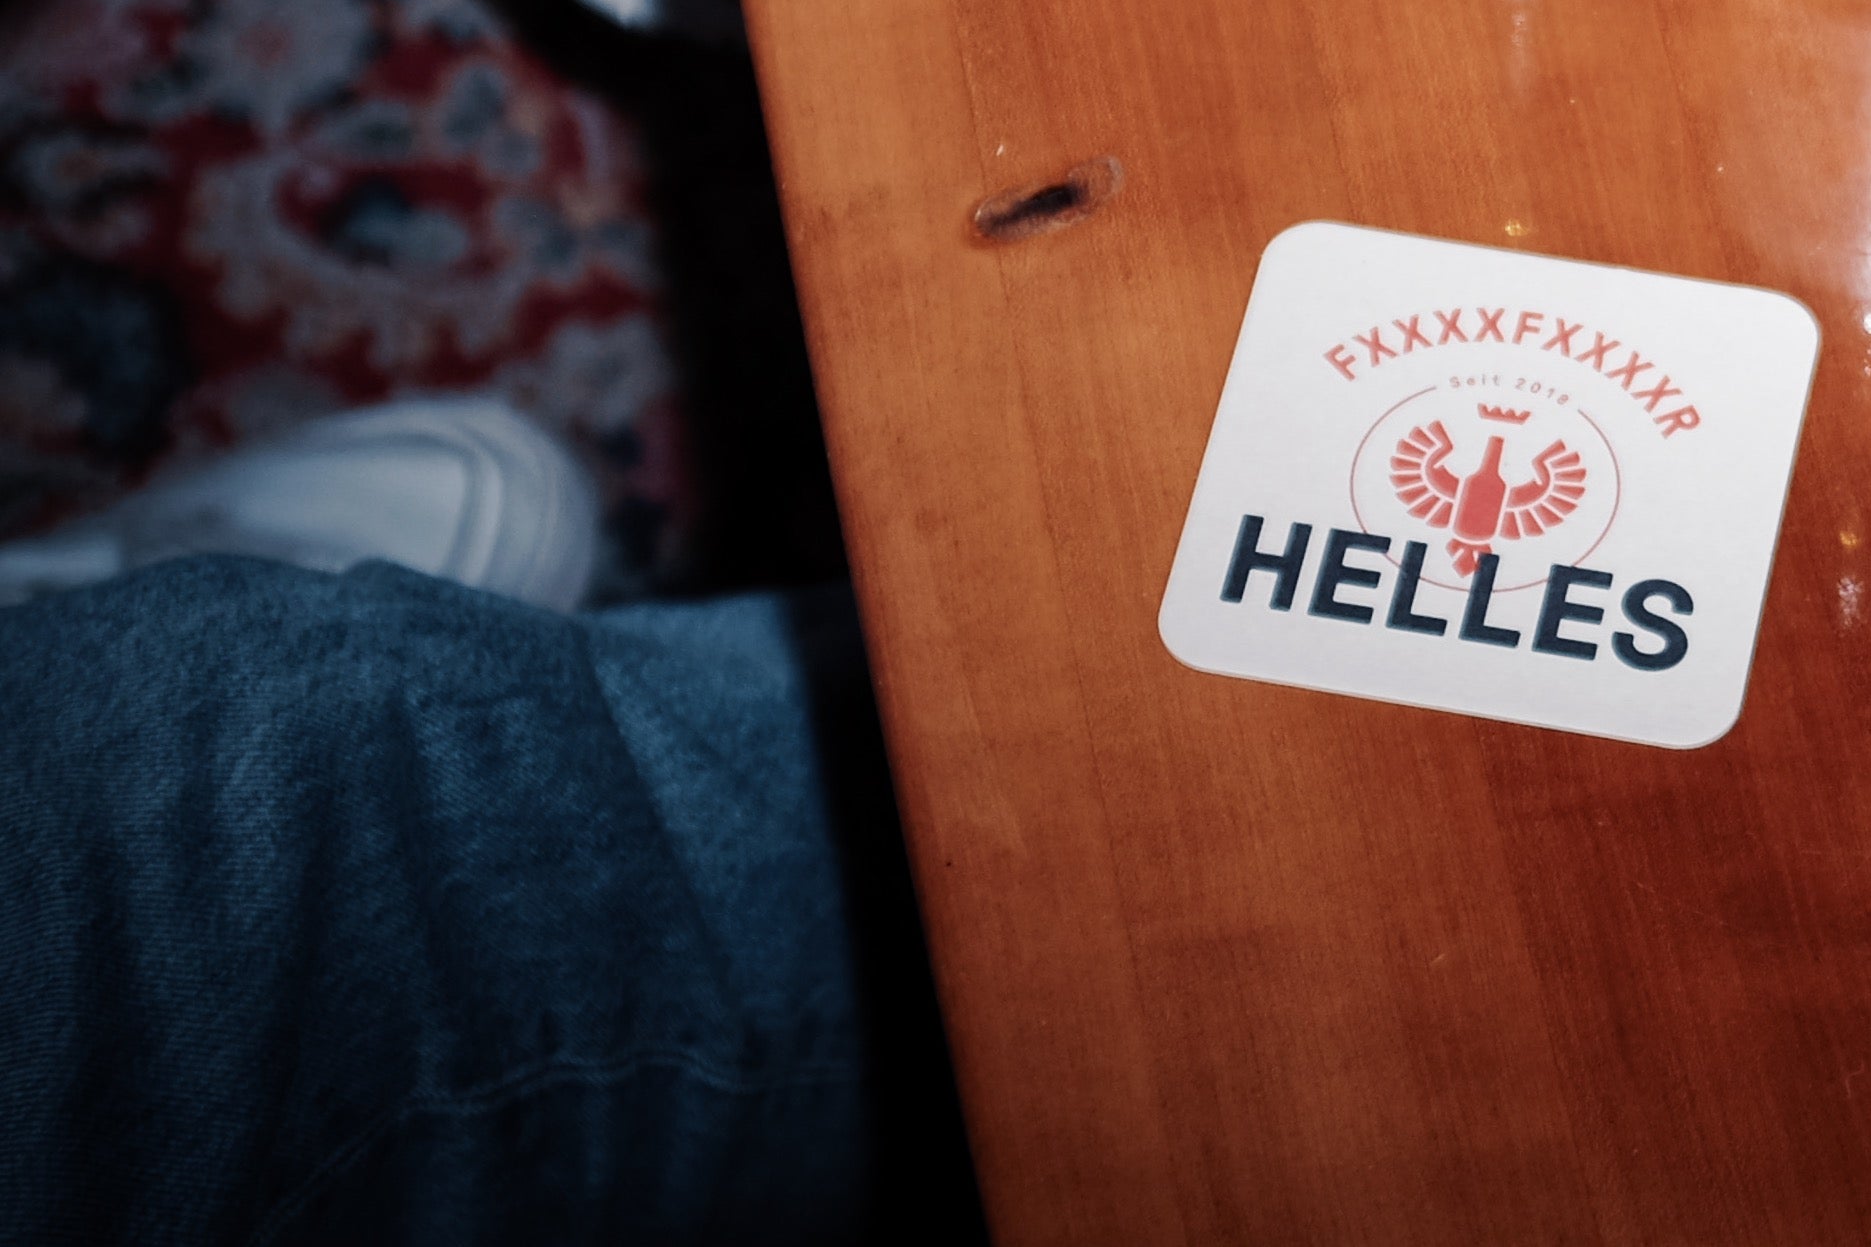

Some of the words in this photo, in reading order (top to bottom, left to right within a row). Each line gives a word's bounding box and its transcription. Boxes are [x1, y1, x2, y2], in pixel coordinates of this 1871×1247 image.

[1323, 307, 1702, 440] FXXXXFXXXXR
[1449, 373, 1501, 390] Seit
[1514, 376, 1571, 407] 2018
[1220, 513, 1695, 672] HELLES
